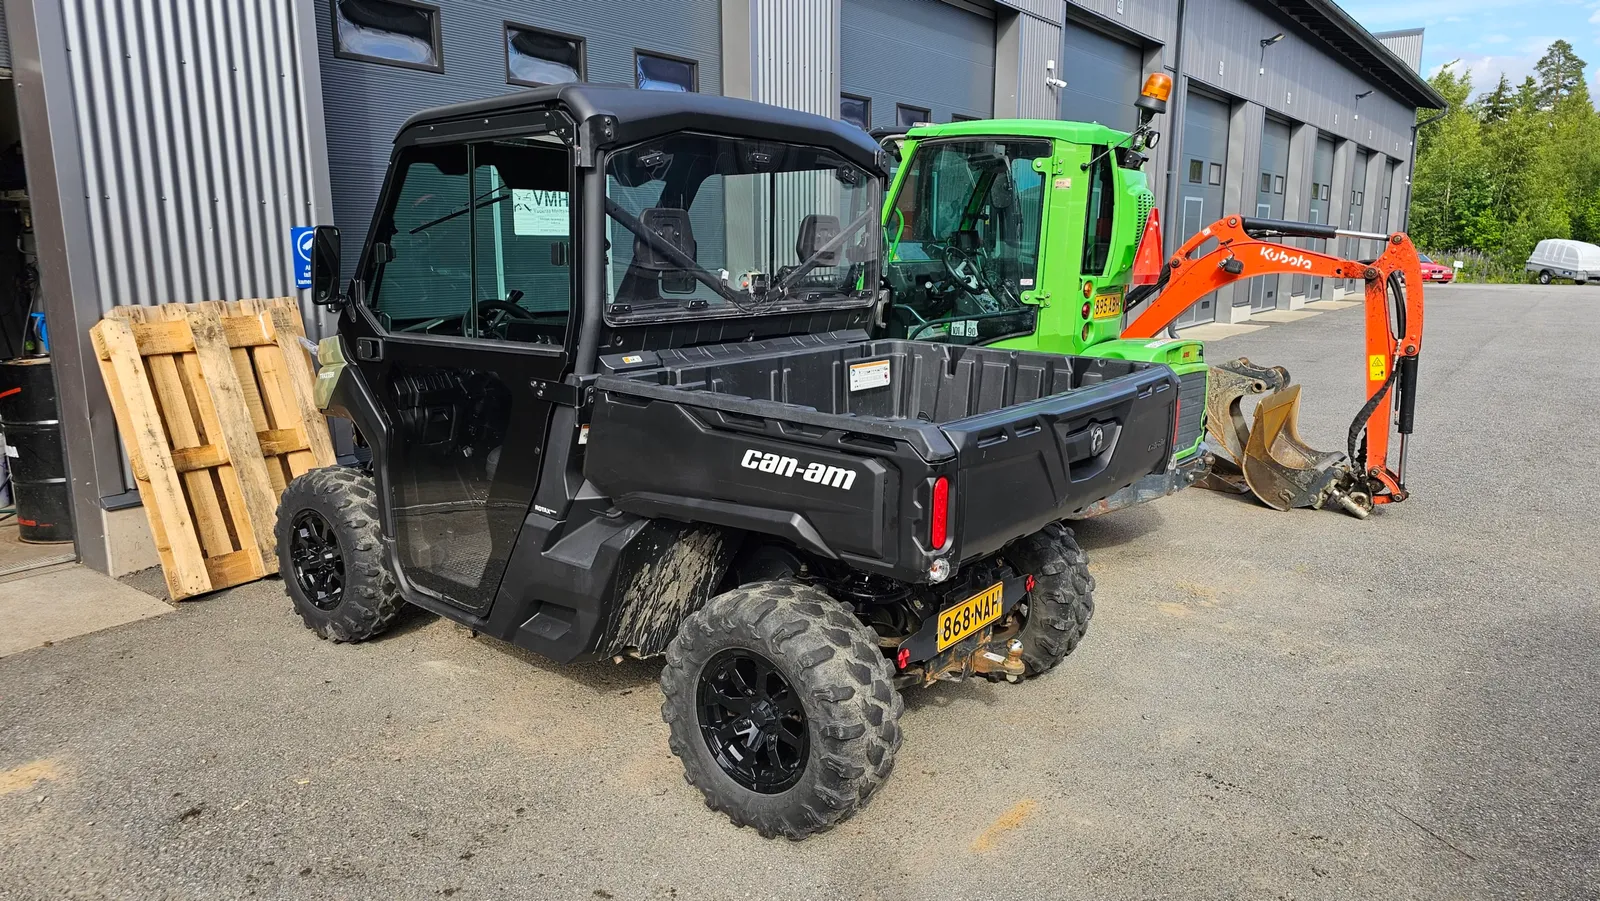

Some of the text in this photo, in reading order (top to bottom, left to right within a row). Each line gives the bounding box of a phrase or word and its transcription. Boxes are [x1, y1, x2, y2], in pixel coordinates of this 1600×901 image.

[1260, 246, 1312, 270] Kubota
[741, 449, 857, 490] can-am
[534, 504, 551, 514] ROTAX
[943, 589, 1001, 642] 868-NAH
